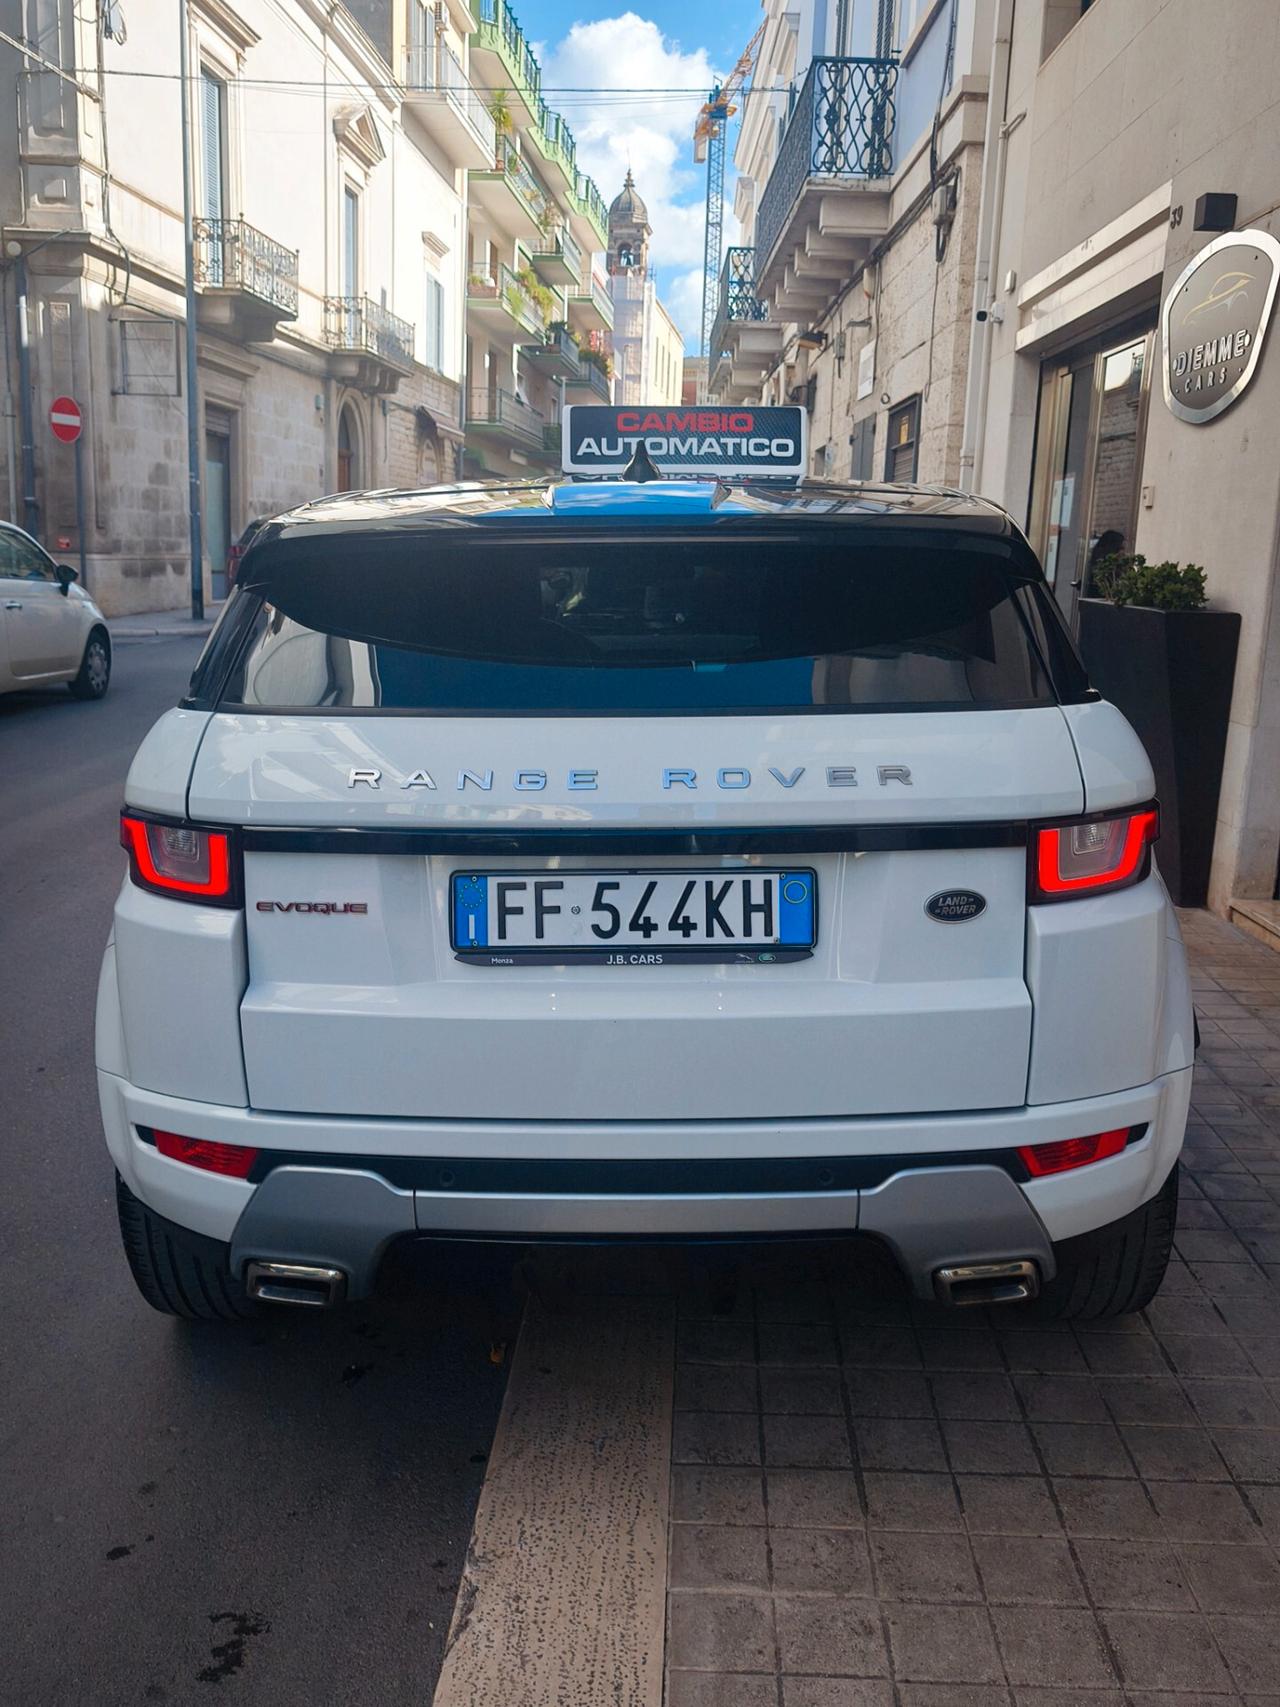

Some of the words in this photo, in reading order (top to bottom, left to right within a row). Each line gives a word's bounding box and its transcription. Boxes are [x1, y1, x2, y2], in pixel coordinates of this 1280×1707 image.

[1175, 329, 1247, 376] DIEMME
[1184, 367, 1227, 393] CARS
[616, 413, 754, 432] CAMBIO
[576, 437, 795, 457] AUTOMATICO
[347, 768, 598, 790] RANGE
[663, 765, 913, 789] ROVER
[256, 901, 368, 915] EVOQUE
[941, 904, 976, 915] ROVER
[491, 957, 514, 965] Monza
[606, 954, 628, 965] J.B.
[630, 954, 663, 965] CARS
